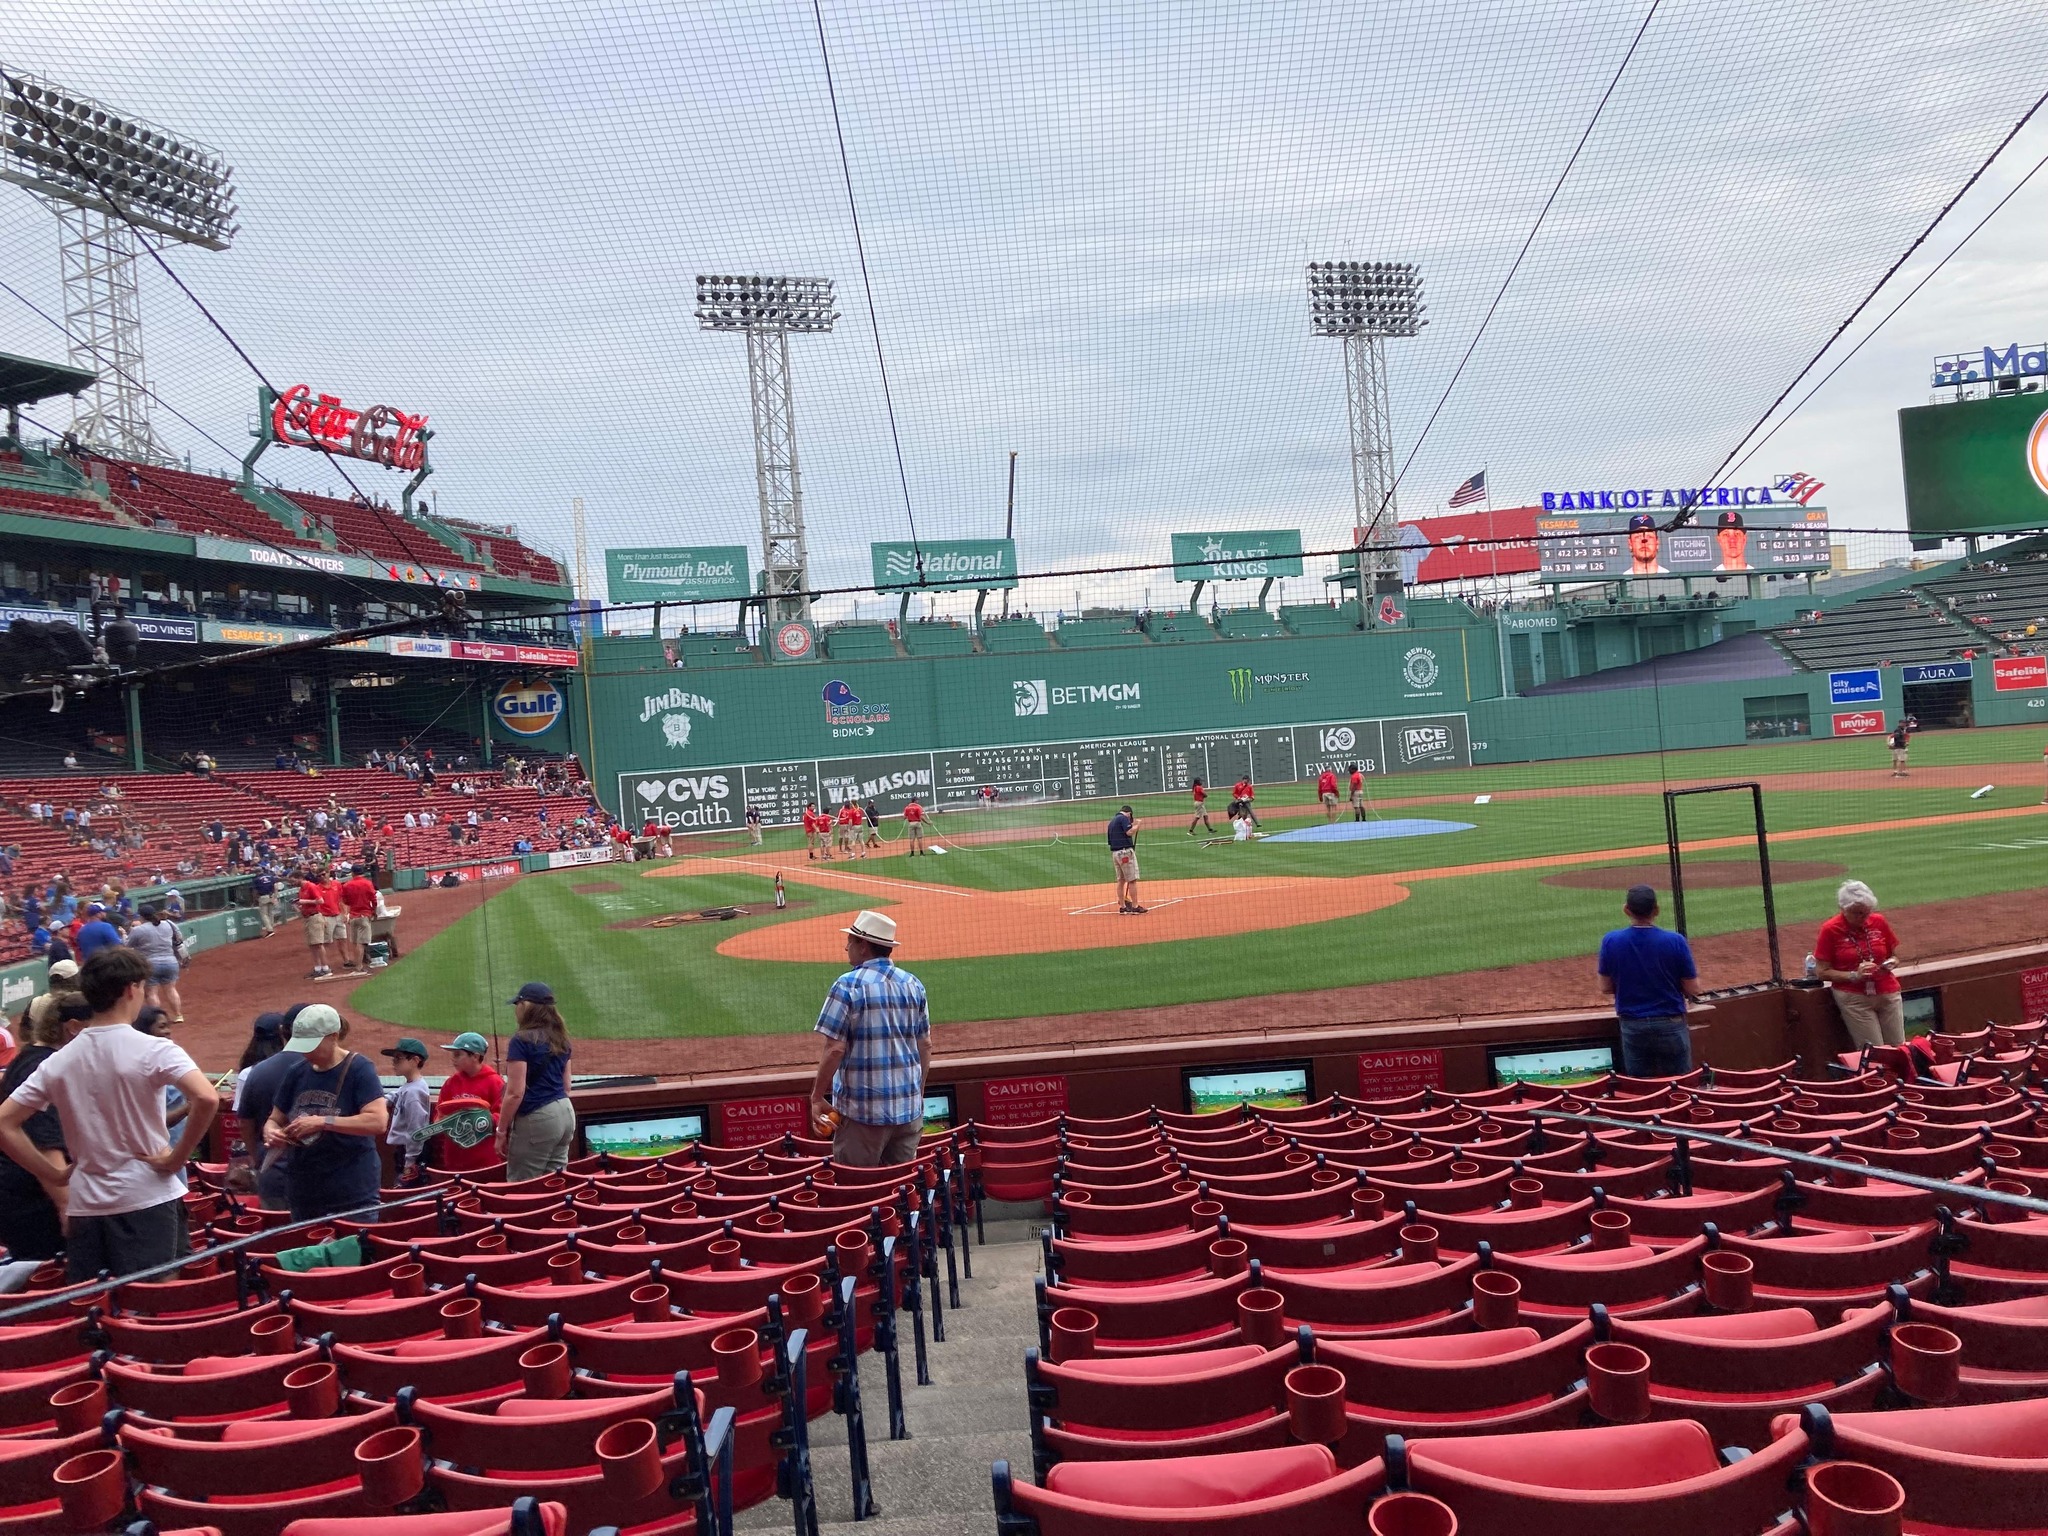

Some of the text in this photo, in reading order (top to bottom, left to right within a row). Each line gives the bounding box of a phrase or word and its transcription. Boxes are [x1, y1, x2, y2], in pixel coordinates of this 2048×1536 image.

[1540, 486, 1773, 510] BANK OF AMERICA
[1540, 520, 1579, 529] YESAVAGE
[1468, 534, 1539, 553] Fanatics
[1674, 540, 1705, 548] PITCHING
[249, 548, 344, 571] TODAY'S STARTERS
[617, 553, 633, 561] More
[914, 550, 1002, 572] National
[1207, 549, 1268, 562] DRAFT
[622, 560, 734, 580] Plymouth Rock
[1213, 562, 1268, 576] KINGS
[685, 577, 736, 585] assurance
[946, 573, 964, 582] Car
[1512, 617, 1558, 629] ABIOMED
[160, 626, 192, 635] VINES
[221, 628, 283, 642] YESAVAGE 3-3
[519, 651, 548, 661] Safelite
[1404, 647, 1436, 660] IBEW 103
[1996, 667, 2045, 678] Safelite
[1254, 673, 1310, 684] MONSTER
[1833, 680, 1849, 688] city
[1052, 683, 1140, 704] BETMGM
[1833, 685, 1865, 695] cruises
[500, 694, 557, 714] Gulf
[640, 688, 715, 722] JIM BEAM
[2027, 700, 2045, 708] 420
[832, 704, 890, 716] RED SOX
[831, 714, 890, 725] SCHOLARS
[1840, 718, 1877, 729] IRVING
[833, 728, 863, 738] BIDMC
[1410, 728, 1446, 745] ACE
[1320, 727, 1356, 752] 160
[1411, 741, 1447, 755] TICKET
[960, 750, 1004, 758] FENWAY
[989, 764, 1012, 772] JUNE
[821, 777, 855, 786] WHO BUT
[667, 775, 729, 802] CVS
[642, 802, 732, 828] Health
[576, 851, 592, 860] TRULY
[1362, 1055, 1438, 1069] CAUTION!
[1383, 1076, 1408, 1084] CLEAR
[988, 1080, 1063, 1096] CAUTION!
[1366, 1086, 1380, 1094] AND
[1397, 1084, 1420, 1092] ALERT
[727, 1103, 801, 1118] CAUTION!
[990, 1104, 1006, 1112] STAY
[478, 1120, 486, 1128] B
[728, 1126, 744, 1134] STAY
[747, 1124, 772, 1133] CLEAR
[775, 1123, 784, 1131] OF
[747, 1134, 757, 1142] BE
[760, 1132, 784, 1140] ALERT
